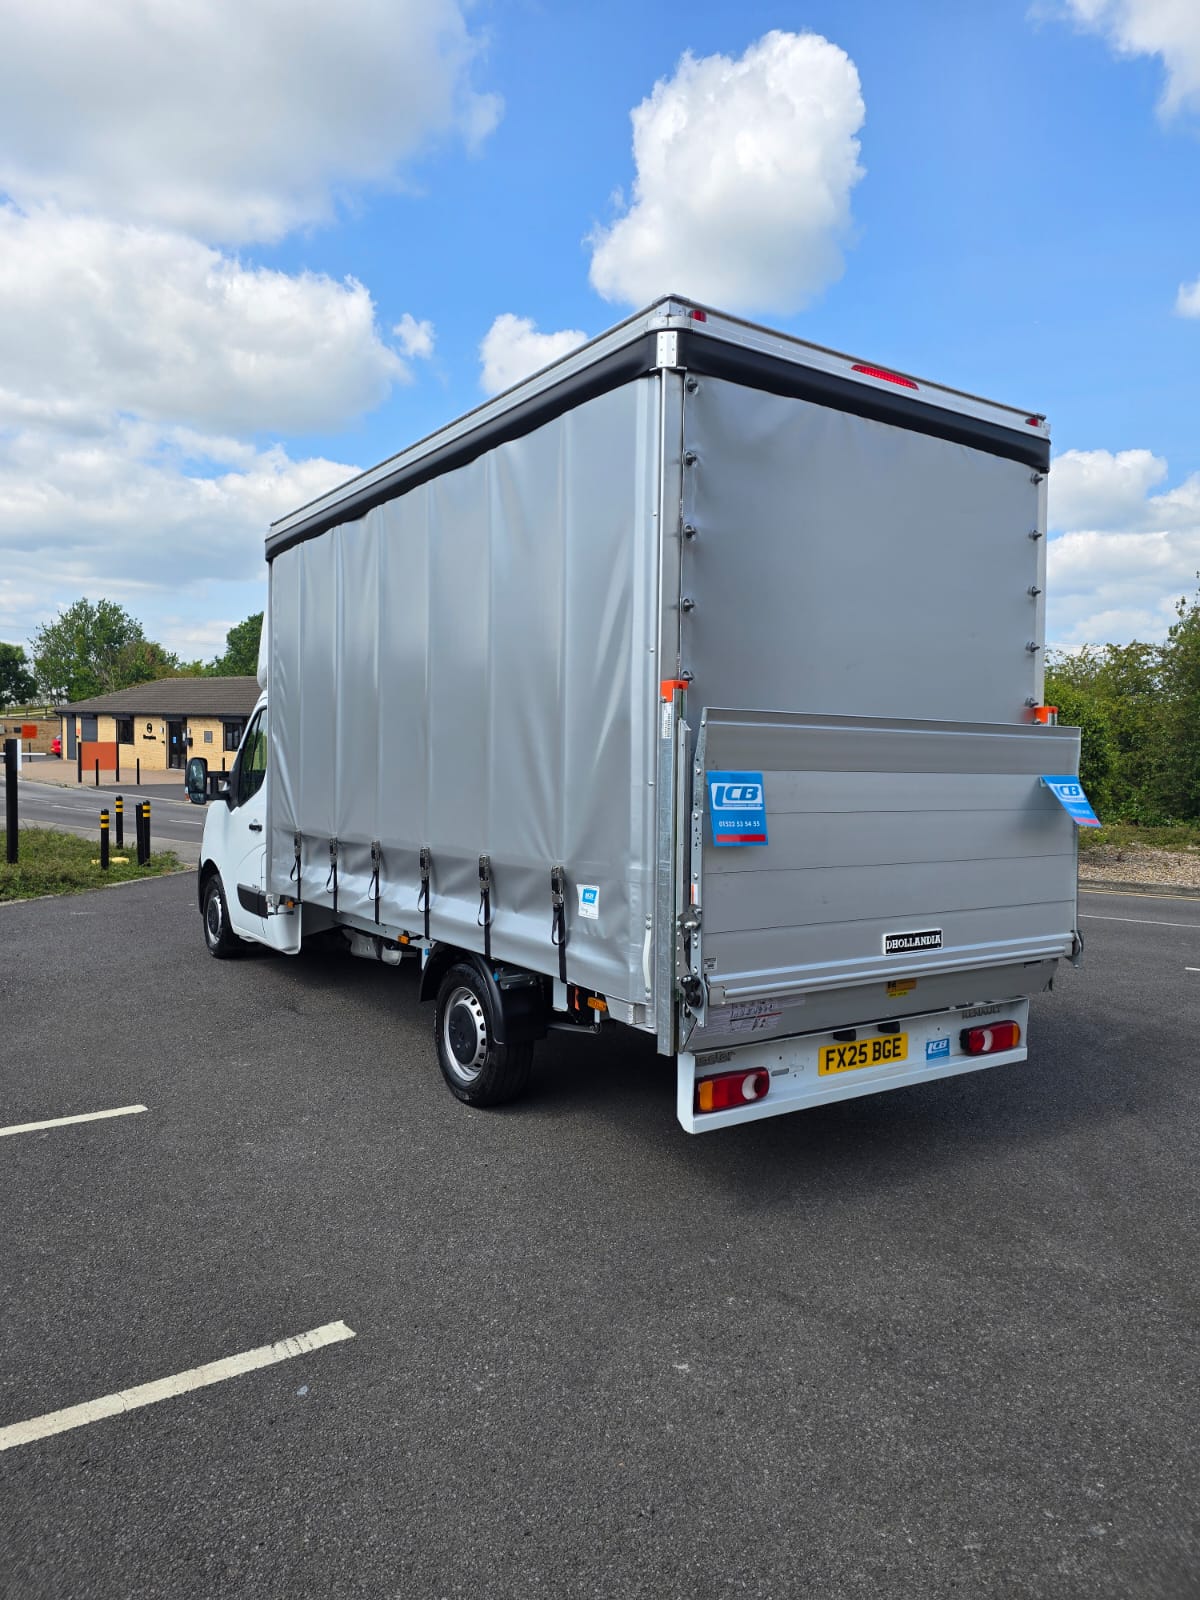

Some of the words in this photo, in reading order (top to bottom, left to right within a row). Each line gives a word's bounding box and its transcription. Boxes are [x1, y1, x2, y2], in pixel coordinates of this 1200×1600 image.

[714, 785, 759, 807] LCB
[886, 934, 941, 950] DHOLLANDIA
[825, 1042, 868, 1071] FX25
[872, 1037, 902, 1062] BGE
[927, 1039, 948, 1055] LCB
